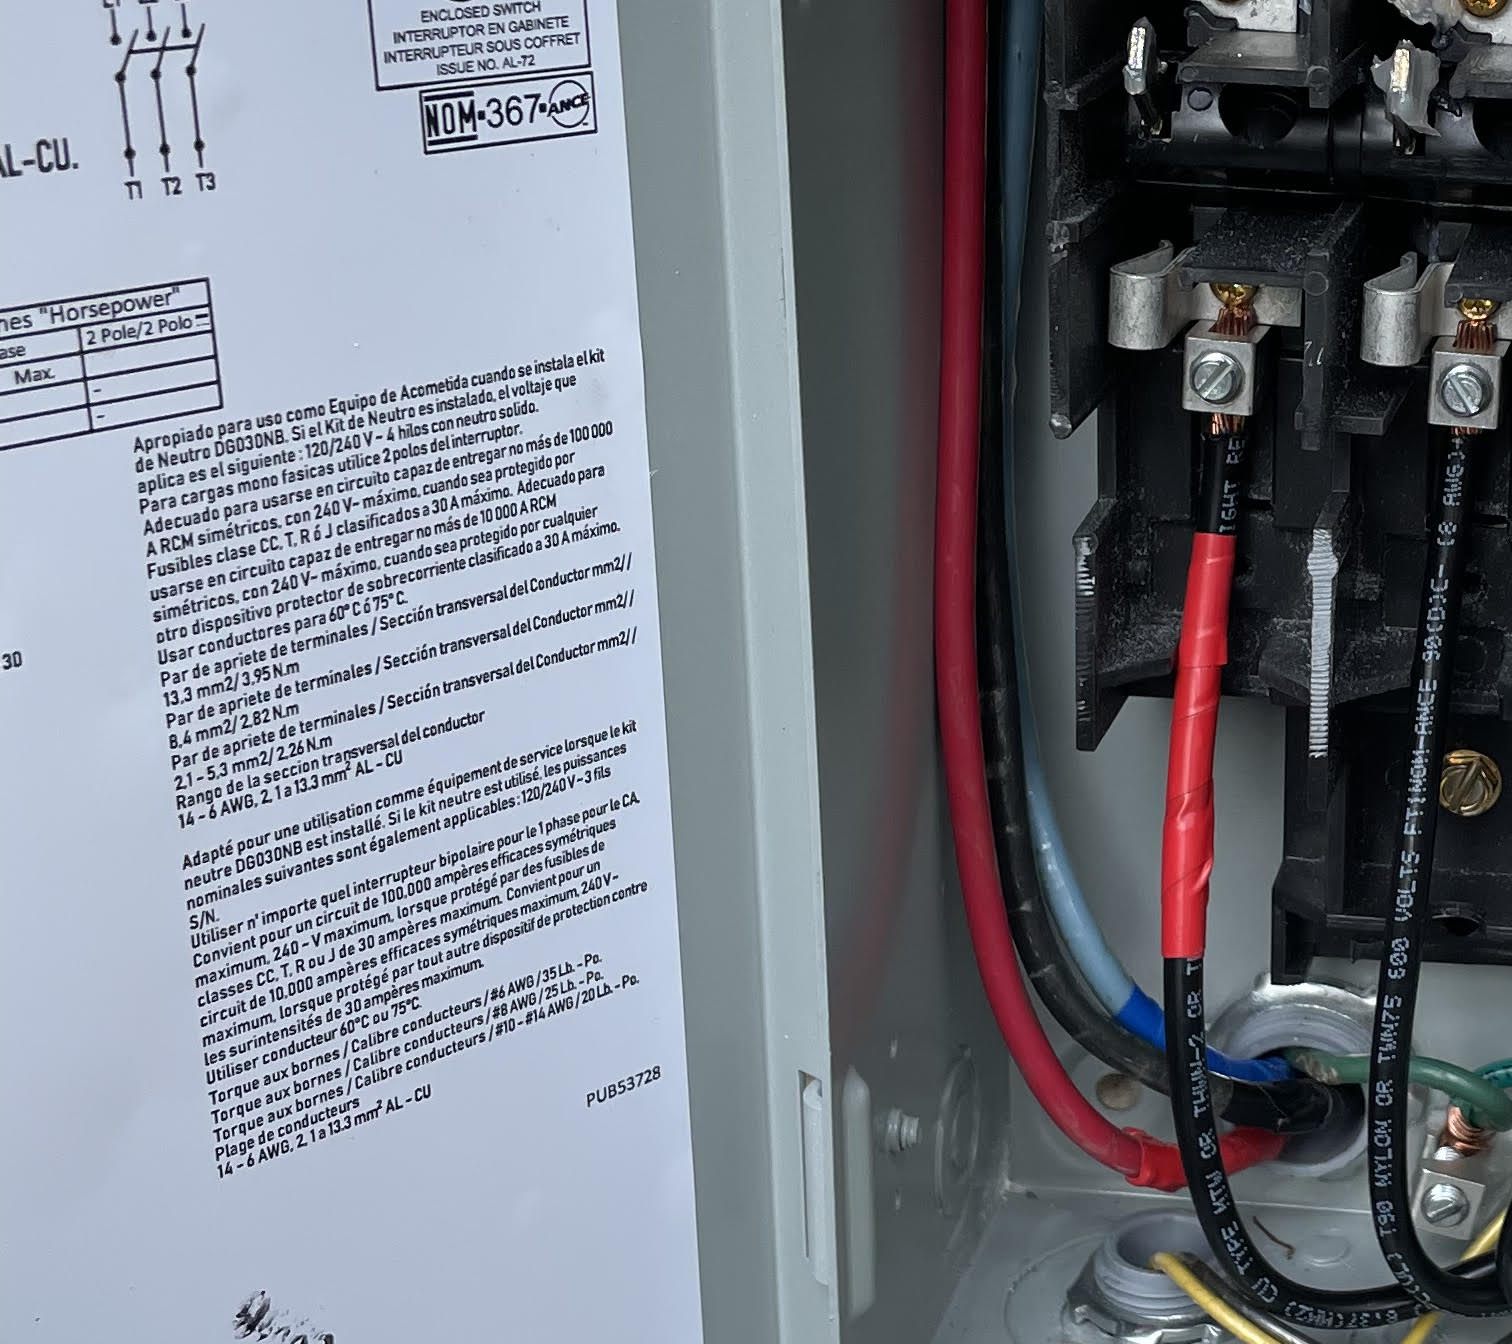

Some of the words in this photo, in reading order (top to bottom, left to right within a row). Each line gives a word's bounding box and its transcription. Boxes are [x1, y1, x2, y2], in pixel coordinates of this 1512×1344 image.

[393, 25, 485, 44] INTERRUPTOR
[488, 22, 505, 35] EN
[508, 16, 570, 33] GABINETE
[420, 5, 490, 23] ENCLOSED
[493, 1, 542, 17] SWITCH
[384, 42, 484, 64] INTERRUPTEUR
[486, 38, 521, 53] SOUS
[524, 32, 581, 49] COFFRET
[436, 61, 474, 76] ISSUE
[477, 58, 499, 71] NO.
[503, 55, 536, 68] AL-72
[124, 180, 143, 200] T1
[161, 176, 182, 196] T2
[195, 171, 216, 192] T3
[40, 287, 180, 324] "Horsepower"
[86, 331, 96, 346] 2
[101, 321, 154, 342] Pole/2
[158, 316, 193, 333] Polo
[14, 368, 55, 385] Max.
[133, 424, 214, 454] Apropiado
[217, 418, 252, 440] para
[256, 413, 282, 428] uso
[286, 404, 326, 423] como
[329, 394, 377, 415] Equipo
[380, 389, 397, 404] de
[400, 375, 469, 401] Acometida
[471, 367, 516, 387] cuando
[517, 365, 533, 378] se
[534, 355, 574, 374] instala
[576, 351, 589, 367] el
[589, 348, 605, 364] kit
[135, 457, 154, 473] de
[157, 447, 211, 468] Neutro
[291, 425, 306, 441] Si
[308, 422, 323, 438] el
[325, 418, 346, 435] Kit
[348, 415, 365, 430] de
[368, 406, 416, 426] Neutro
[418, 403, 434, 416] es
[498, 385, 510, 400] el
[511, 378, 553, 397] voltaje
[554, 375, 577, 393] que
[139, 496, 177, 515] Para
[181, 484, 234, 506] cargas
[237, 475, 279, 494] mono
[281, 463, 335, 484] fasicas
[338, 453, 381, 473] utilice
[382, 448, 392, 463] 2
[392, 444, 428, 465] polos
[430, 436, 451, 453] del
[451, 424, 523, 448] interruptor.
[182, 839, 234, 871] Adapté
[237, 832, 271, 856] pour
[274, 824, 300, 841] une
[303, 802, 372, 832] utilisation
[375, 786, 425, 810] comme
[427, 760, 502, 794] équipement
[503, 757, 518, 771] de
[519, 744, 563, 766] service
[564, 730, 608, 753] lorsque
[609, 726, 621, 739] le
[622, 720, 637, 735] kit
[184, 866, 232, 890] neutre
[306, 833, 329, 852] est
[388, 810, 401, 826] Si
[403, 808, 416, 822] le
[418, 800, 436, 817] kit
[438, 788, 482, 811] neutre
[484, 779, 503, 796] est
[543, 763, 561, 778] les
[563, 743, 627, 775] puissances
[1394, 850, 1420, 922] VOLTS
[1387, 936, 1411, 979] 600
[1377, 994, 1402, 1064] TWN75
[585, 1065, 662, 1108] PUB53728
[1376, 1078, 1394, 1107] OR
[215, 1138, 255, 1162] Plage
[258, 1130, 274, 1145] de
[277, 1098, 360, 1138] conducteurs
[1374, 1119, 1394, 1188] NYLON
[1220, 1221, 1252, 1276] TYPE
